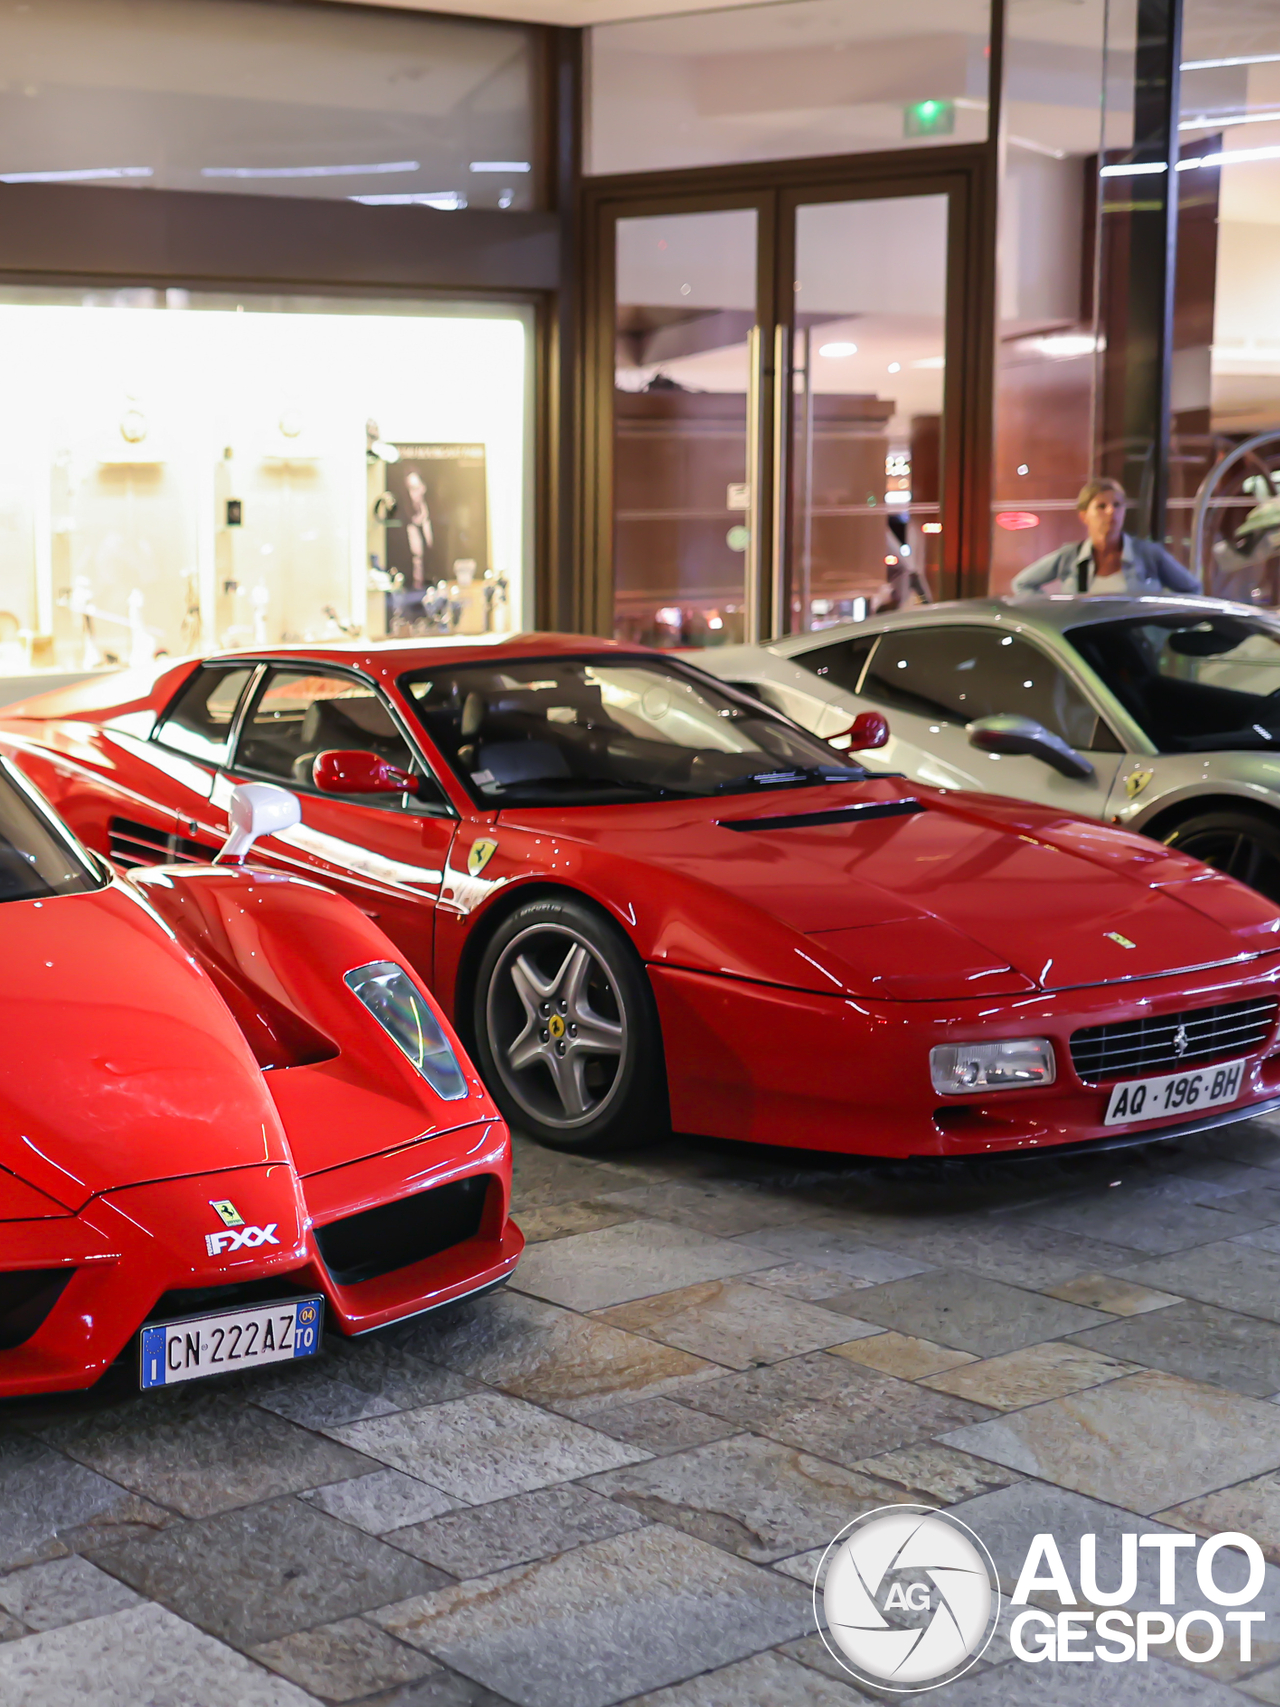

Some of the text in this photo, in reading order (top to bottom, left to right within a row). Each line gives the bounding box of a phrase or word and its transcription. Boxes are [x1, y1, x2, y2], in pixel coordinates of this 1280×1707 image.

[210, 1223, 281, 1255] FXX
[302, 1309, 313, 1321] 04
[296, 1327, 314, 1349] TO
